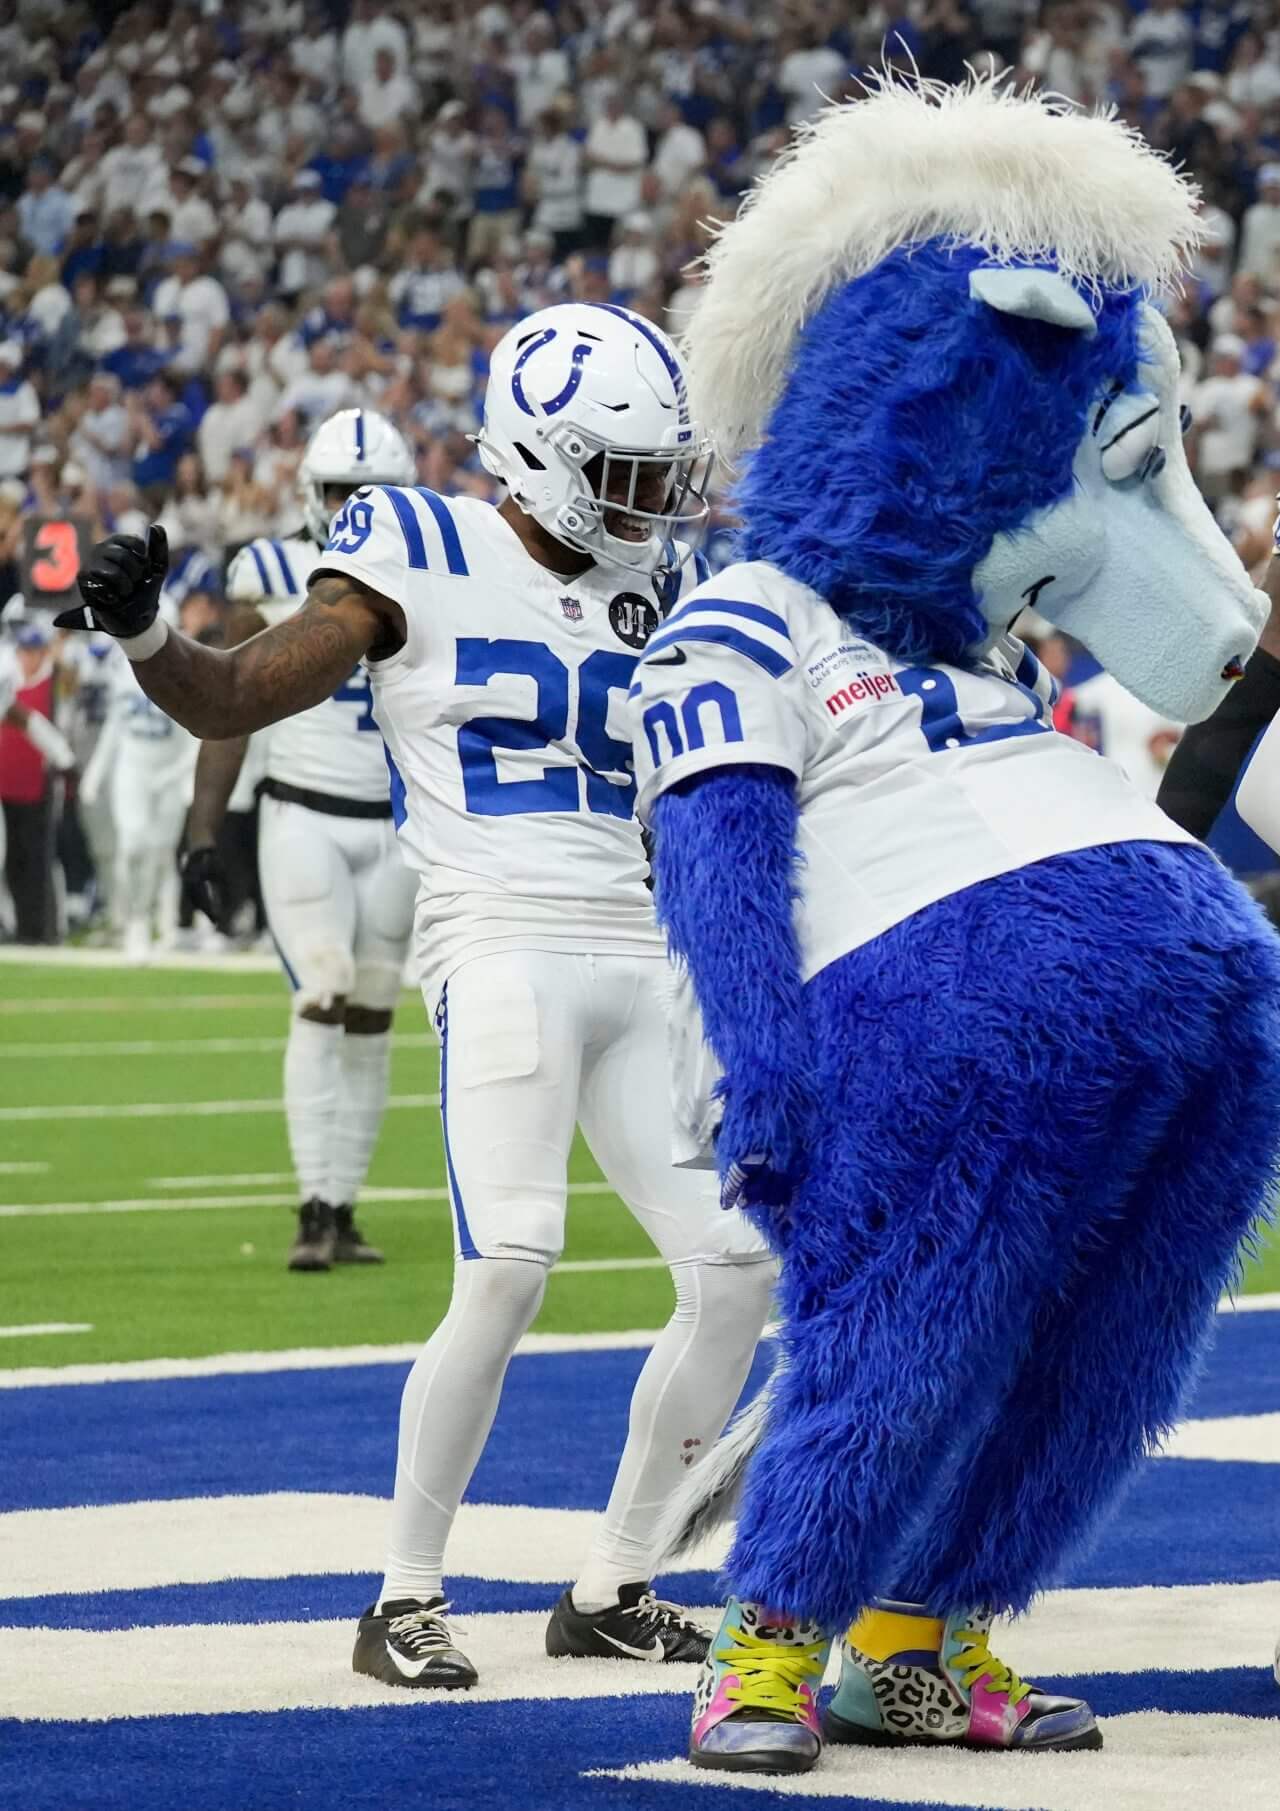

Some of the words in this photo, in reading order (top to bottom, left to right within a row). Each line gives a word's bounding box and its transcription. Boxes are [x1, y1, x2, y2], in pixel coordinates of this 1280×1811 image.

[32, 520, 80, 592] 3
[807, 651, 839, 676] Peyton
[825, 671, 897, 717] meijer
